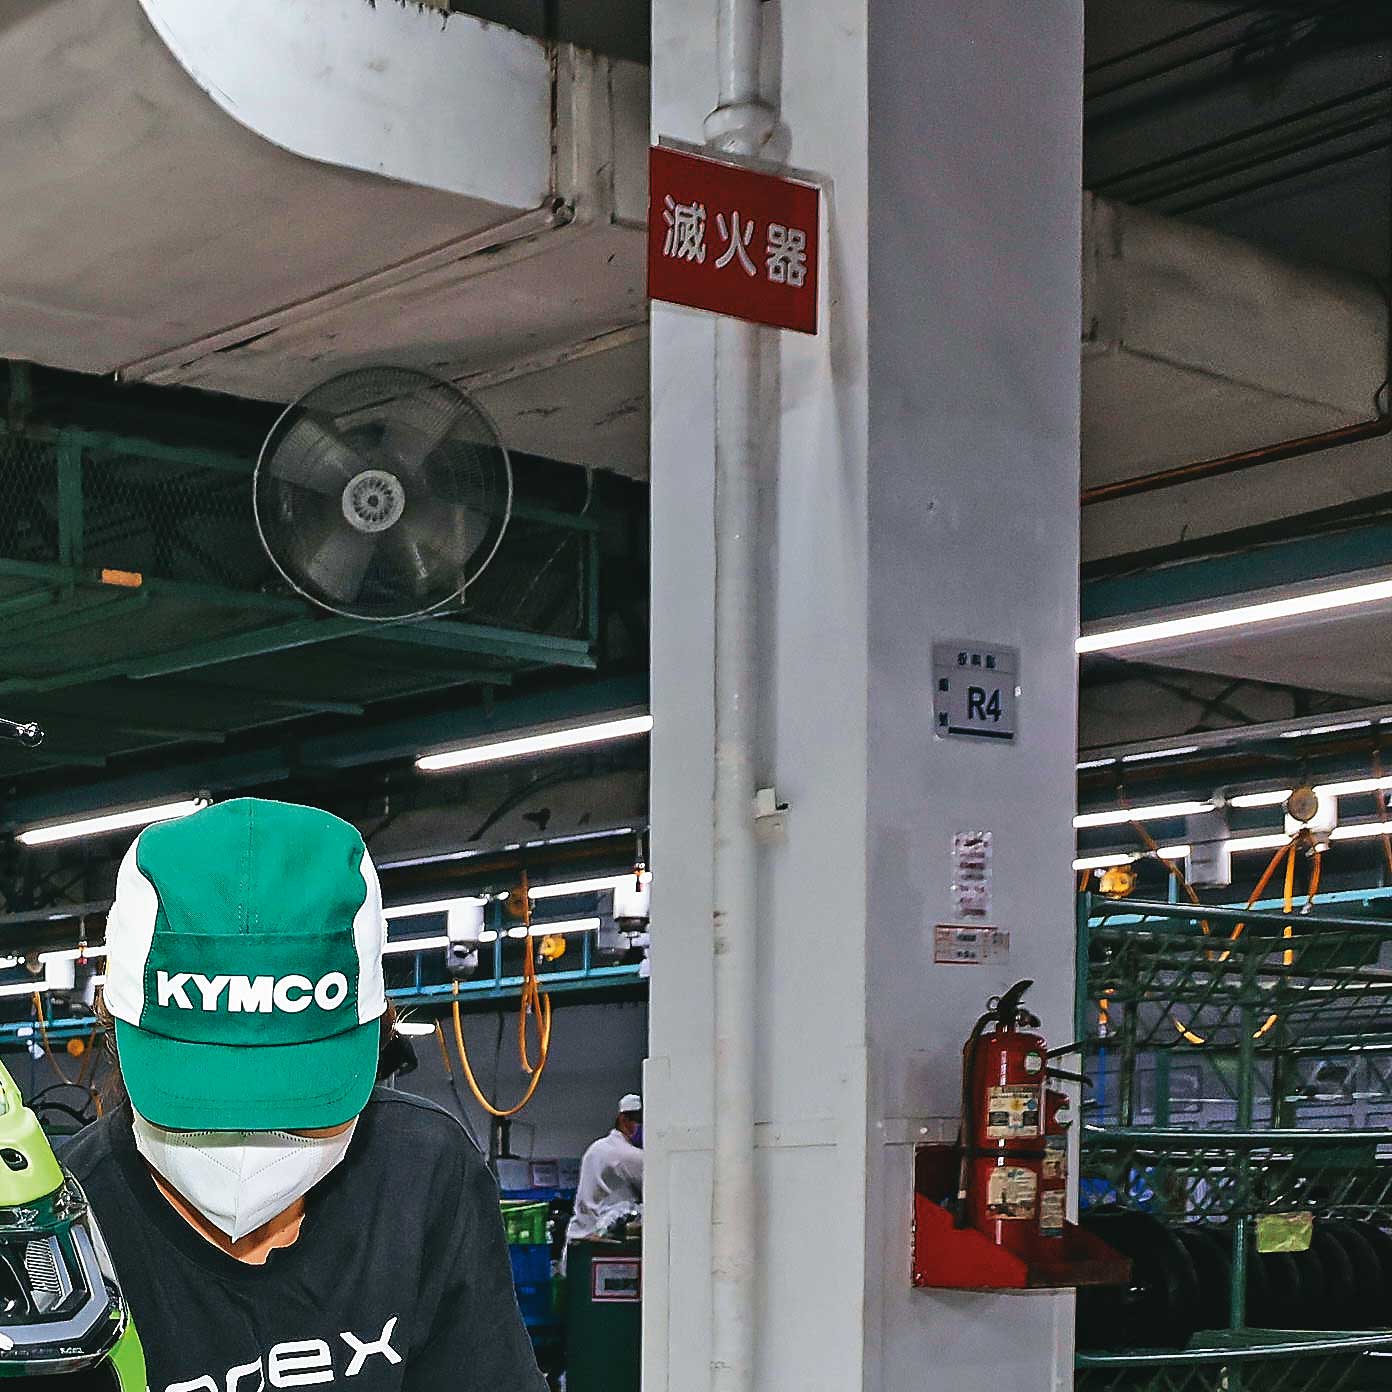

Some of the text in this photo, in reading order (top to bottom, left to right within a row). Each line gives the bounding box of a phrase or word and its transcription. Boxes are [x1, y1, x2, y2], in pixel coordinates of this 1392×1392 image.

[662, 194, 807, 288] 滅火器
[967, 685, 1002, 722] R4
[156, 970, 348, 1013] KYMCO
